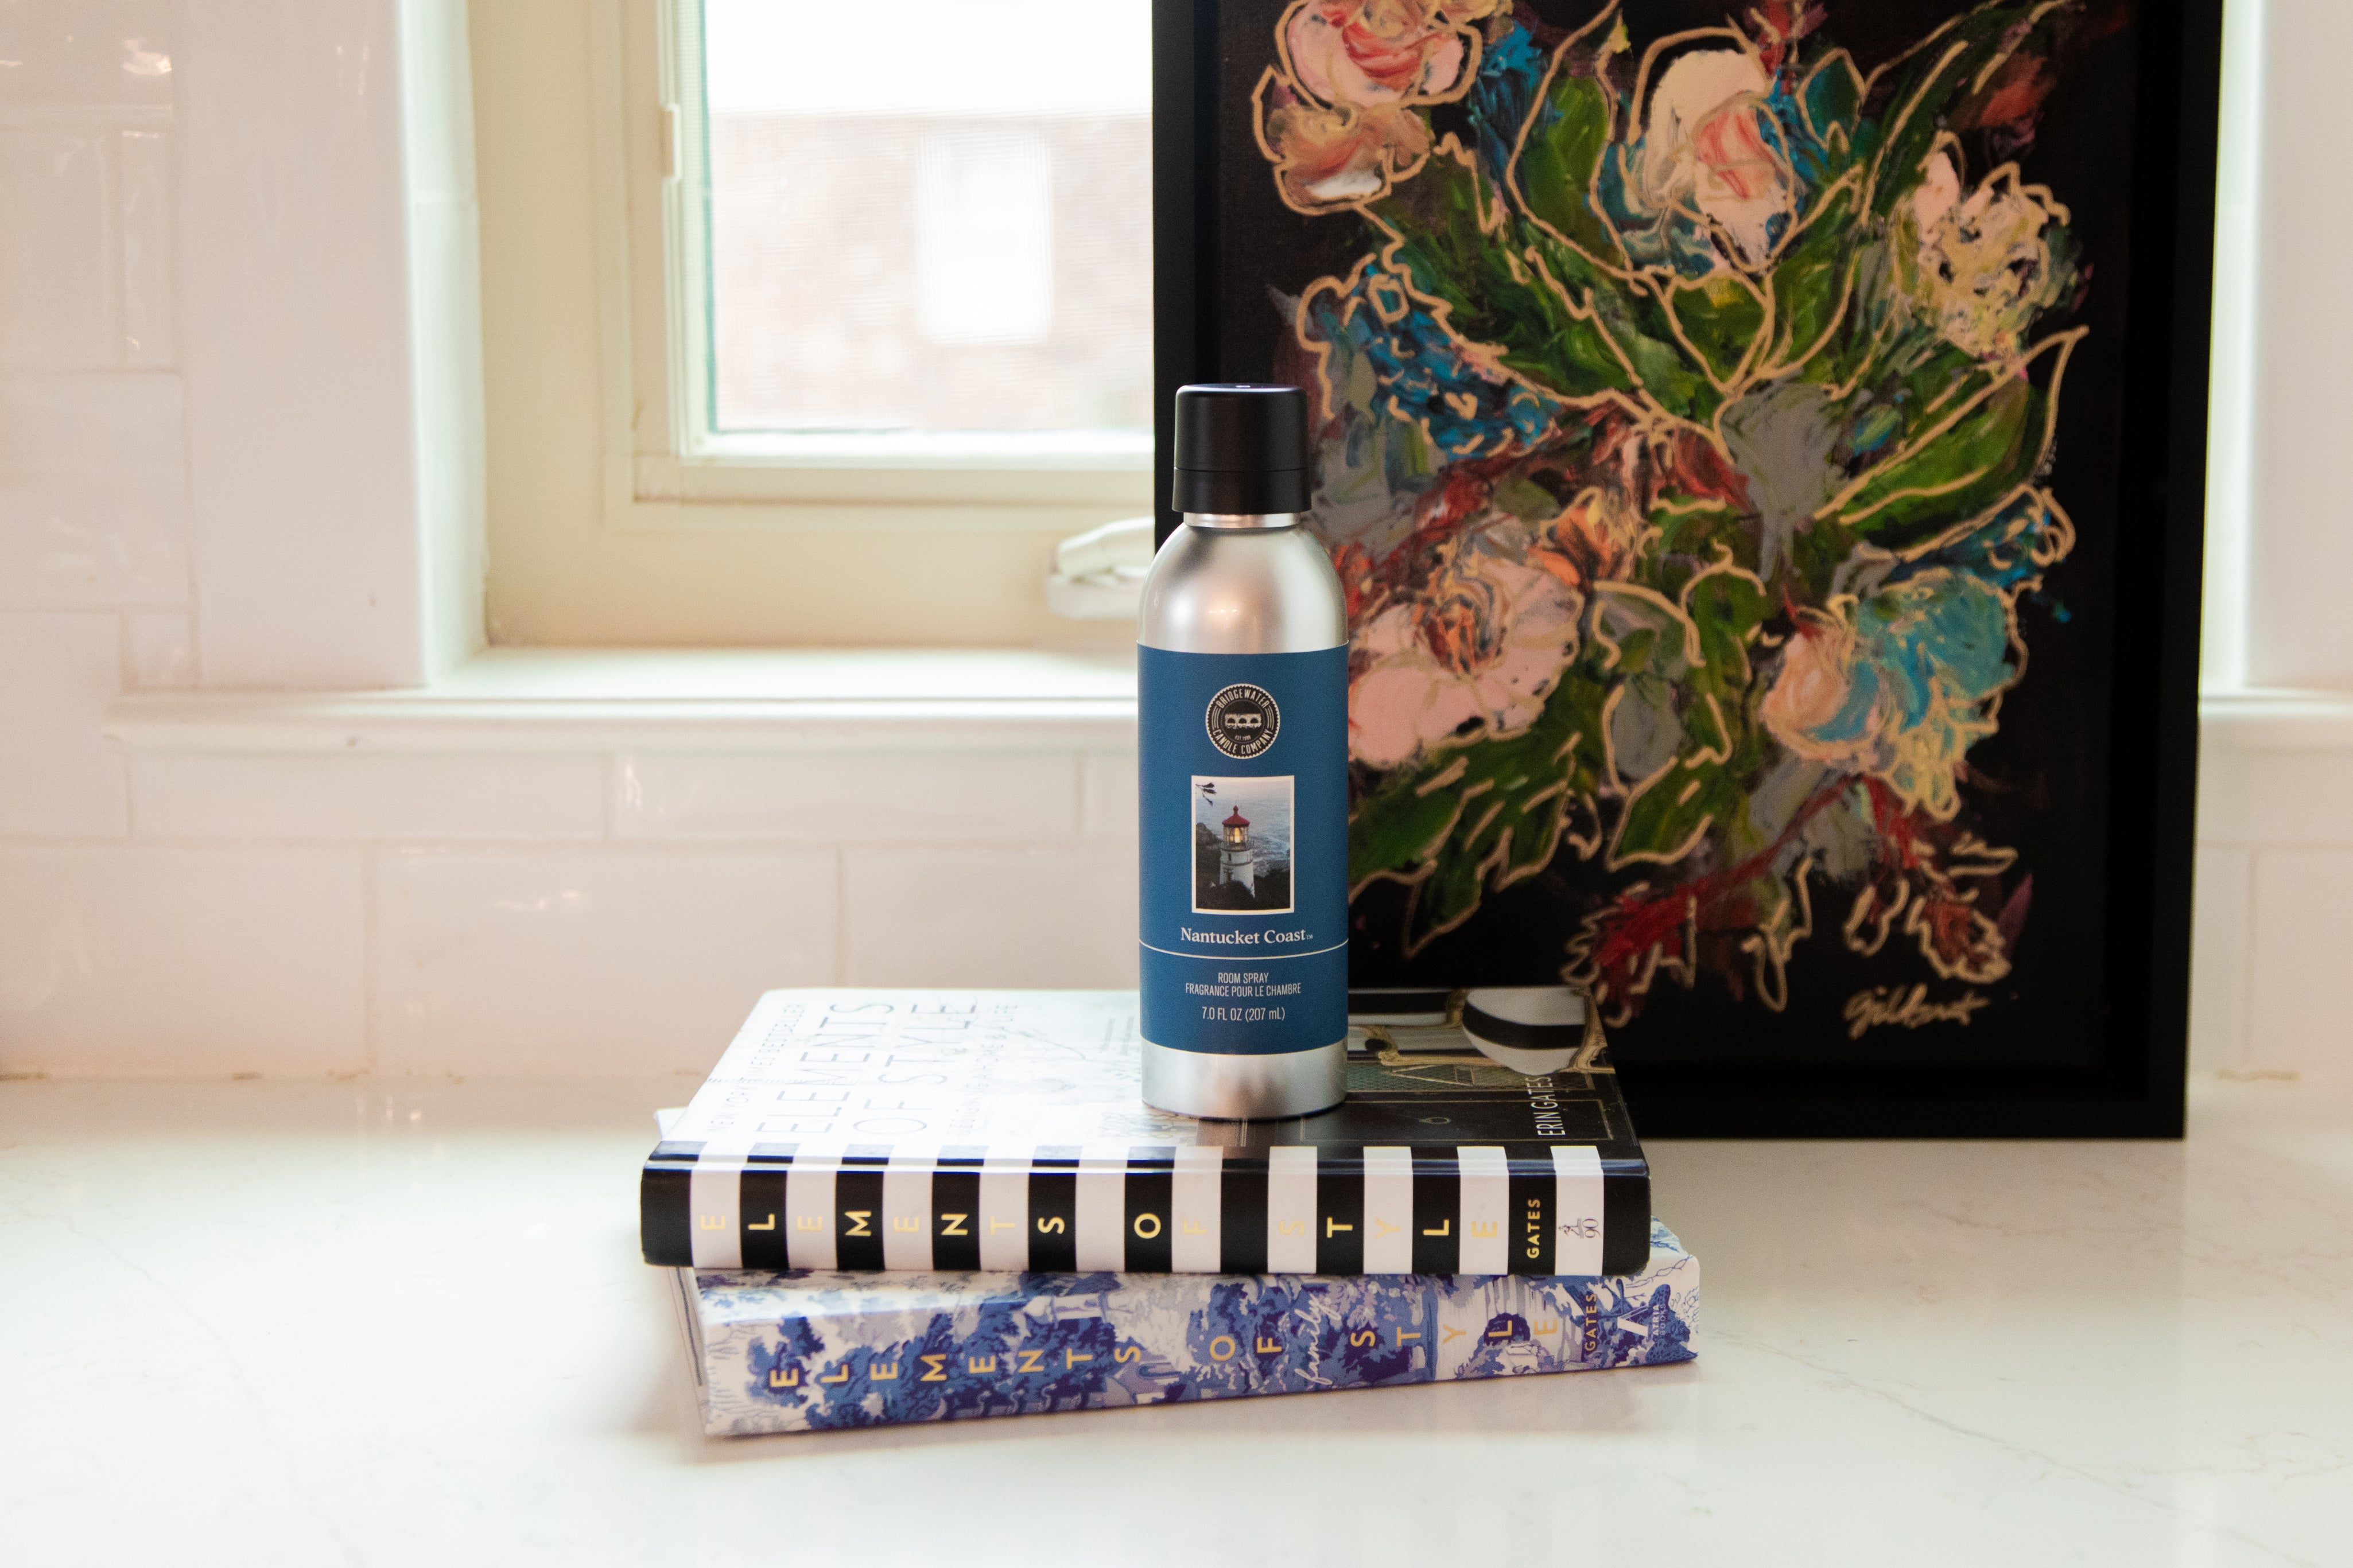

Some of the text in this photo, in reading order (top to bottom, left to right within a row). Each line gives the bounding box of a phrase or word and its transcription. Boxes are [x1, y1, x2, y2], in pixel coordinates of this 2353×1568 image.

[1216, 689, 1270, 709] BRIDGEWATER
[1213, 729, 1273, 754] CANDLE COMPANY
[1181, 927, 1260, 944] Nantucket
[1185, 983, 1301, 997] FRAGRANCE POUR LE CHAMBRE
[1218, 972, 1269, 983] ROOM SPRAY
[1202, 1006, 1285, 1022] 7.0 FL OZ (207 mL)
[756, 1004, 895, 1133] ELEMENTS
[853, 1004, 977, 1134] OF STYLE
[1525, 1077, 1566, 1135] ERIN GATES
[1527, 1199, 1541, 1258] GATES
[1584, 1294, 1598, 1351] GATES
